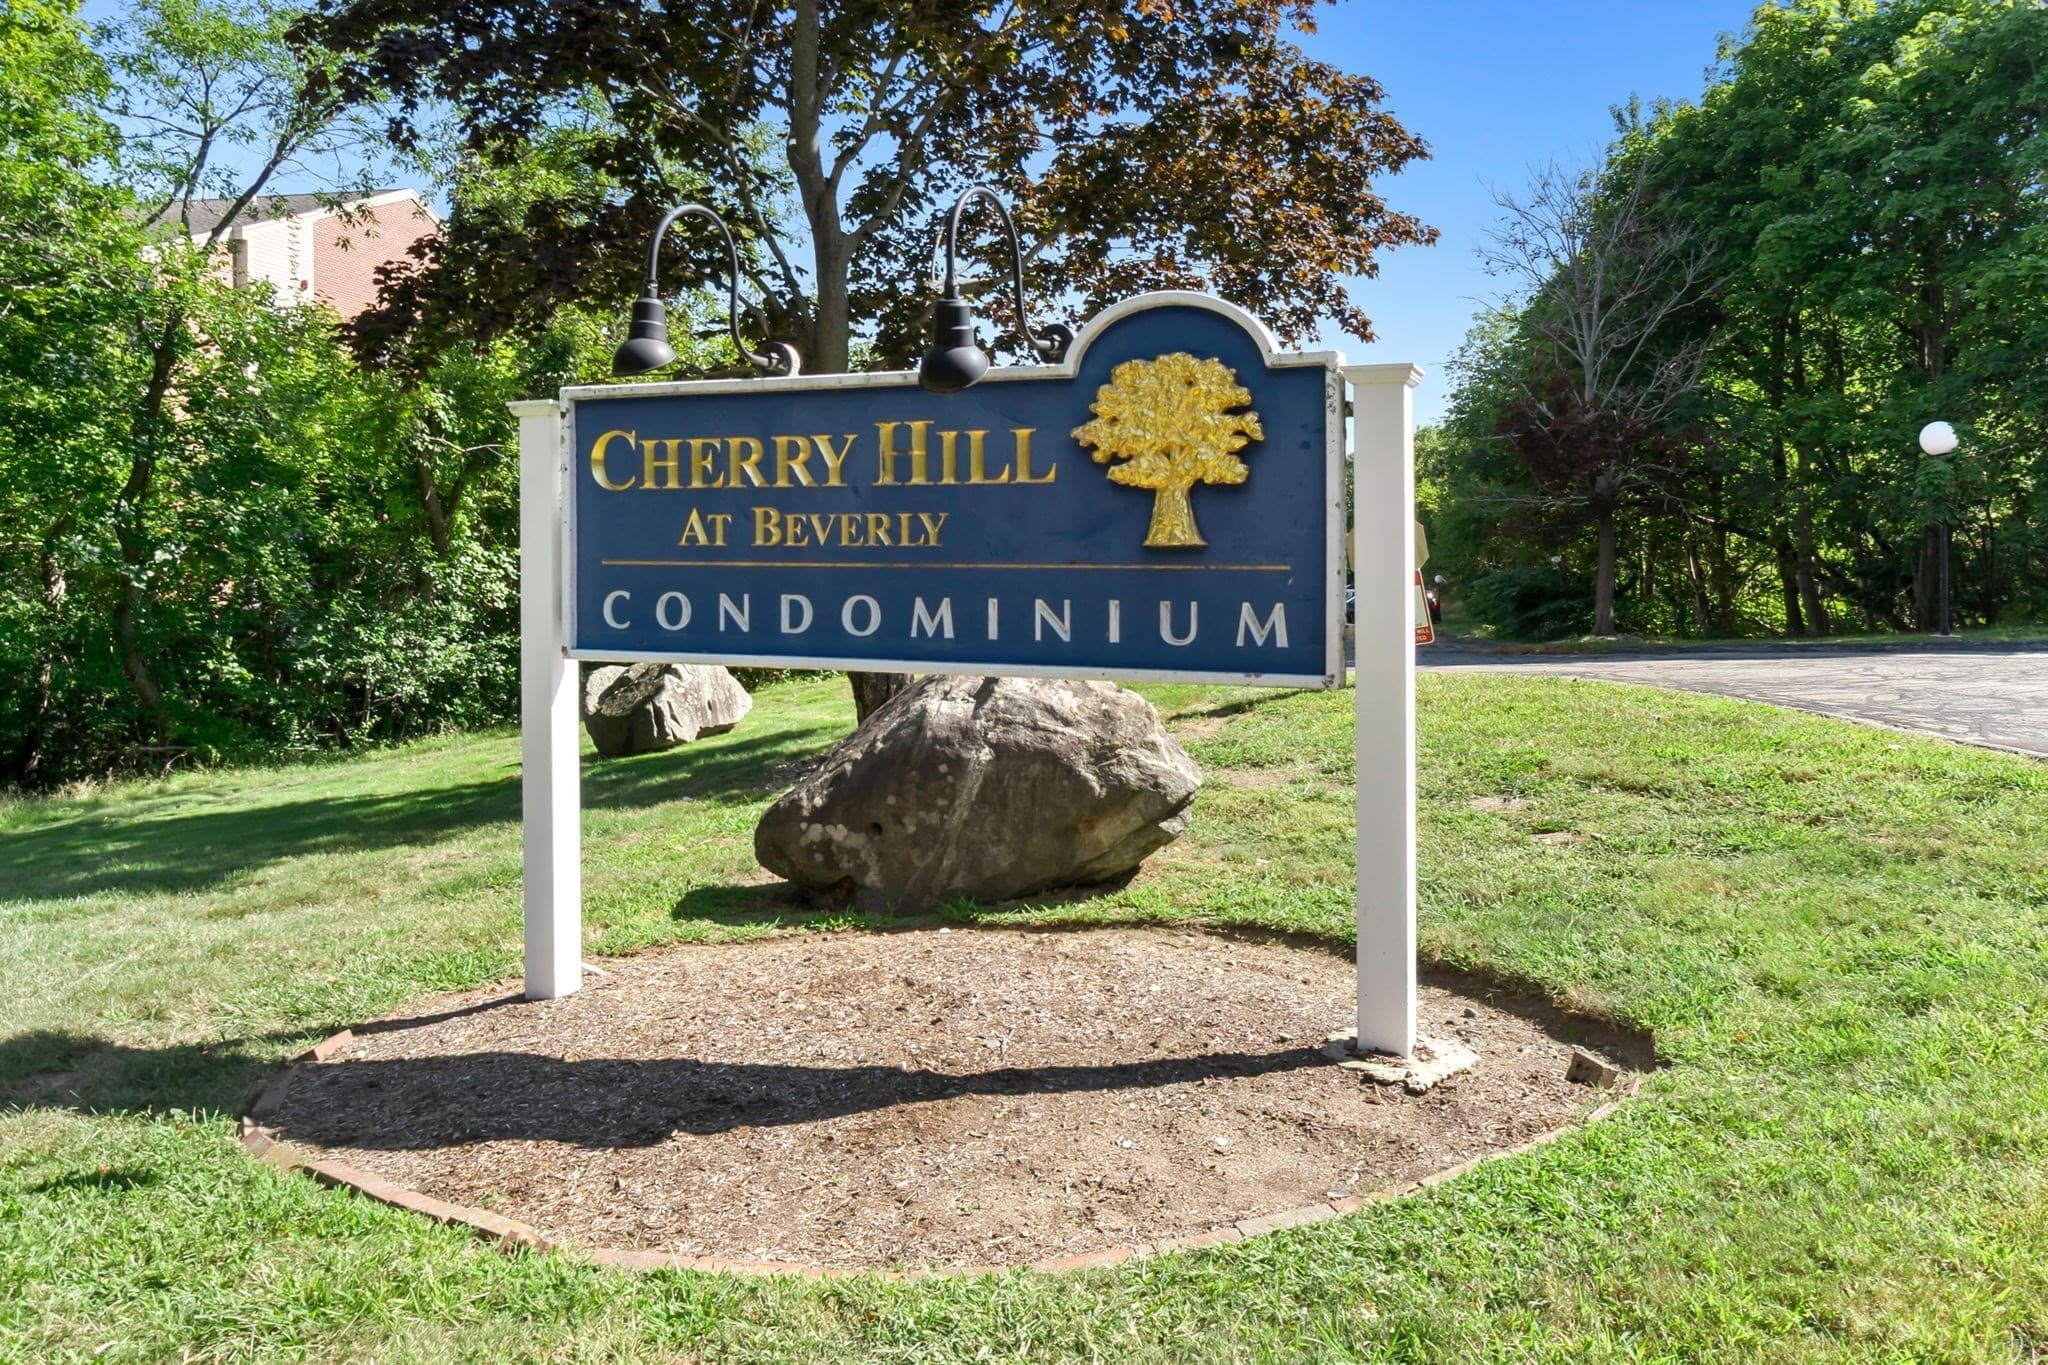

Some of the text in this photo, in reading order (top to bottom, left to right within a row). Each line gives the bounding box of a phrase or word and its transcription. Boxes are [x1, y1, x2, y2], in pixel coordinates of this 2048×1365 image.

[590, 420, 1057, 491] CHERRY HILL
[679, 506, 950, 548] AT BEVERLY
[602, 589, 1290, 649] CONDOMINIUM
